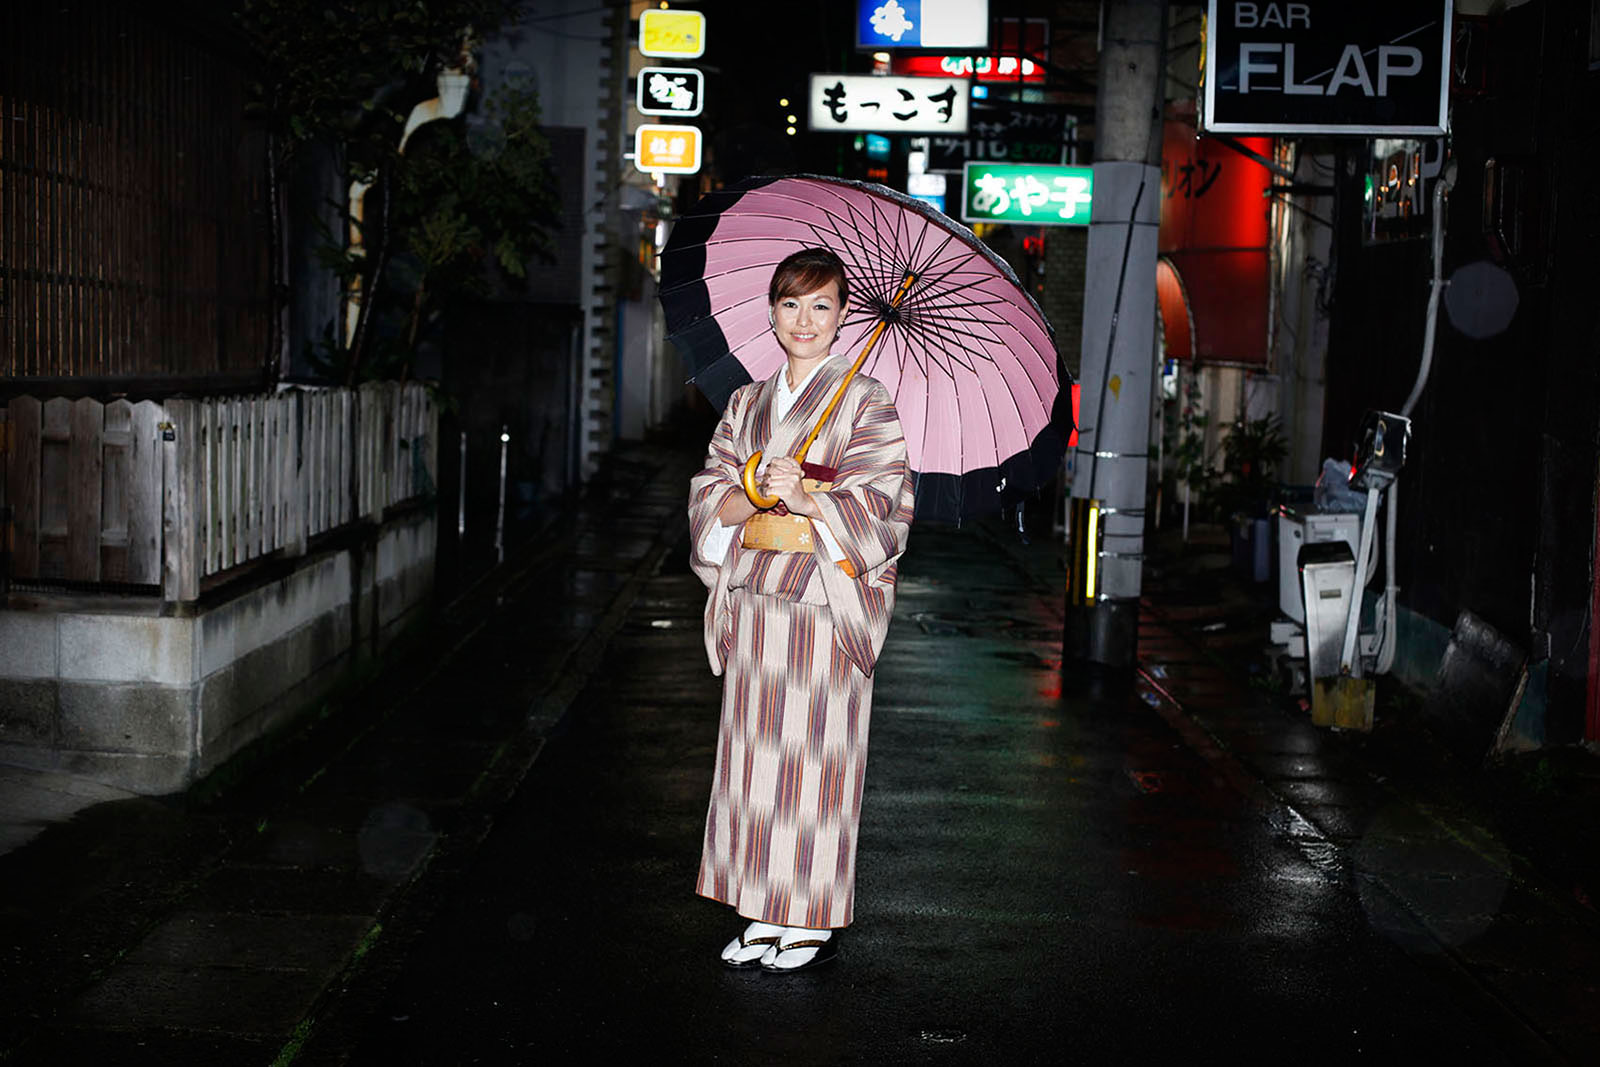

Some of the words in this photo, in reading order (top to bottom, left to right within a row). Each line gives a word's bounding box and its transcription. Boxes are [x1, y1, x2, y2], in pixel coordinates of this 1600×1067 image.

[1234, 1, 1311, 30] BAR
[1238, 42, 1424, 98] FLAP
[822, 81, 957, 124] もっこす
[972, 172, 1092, 219] あや子
